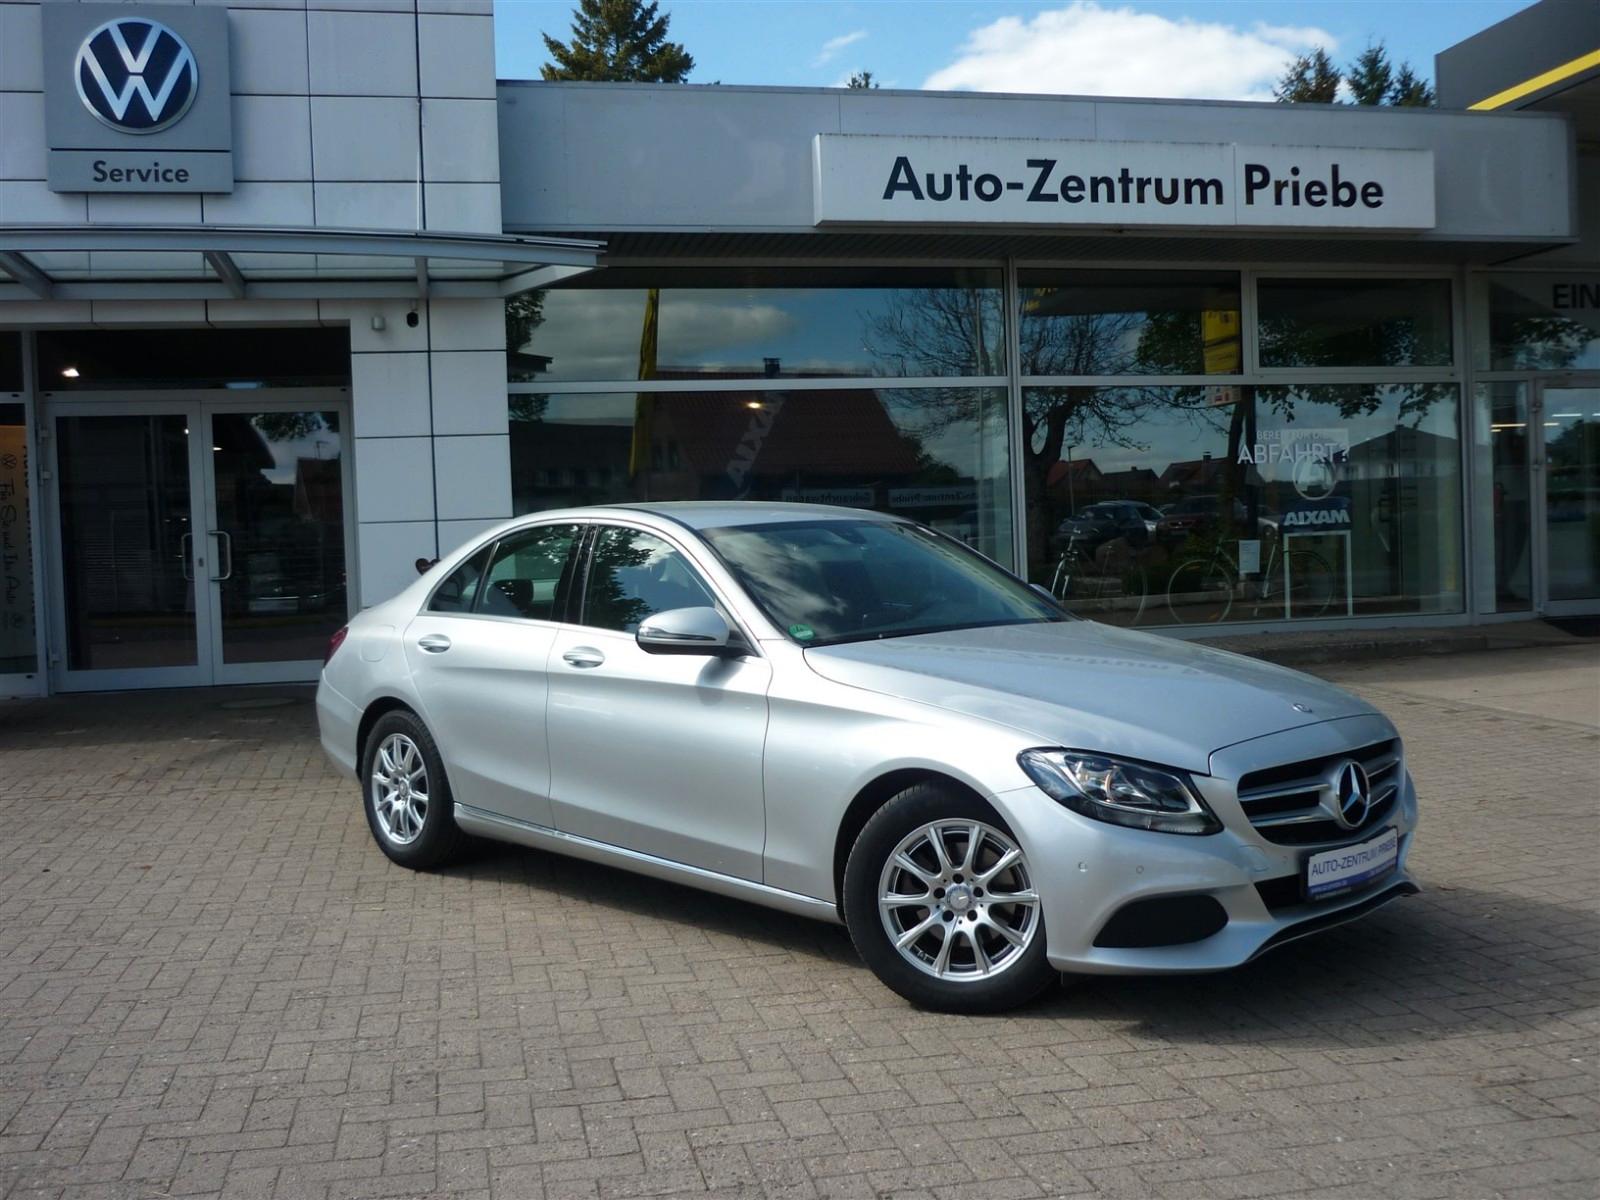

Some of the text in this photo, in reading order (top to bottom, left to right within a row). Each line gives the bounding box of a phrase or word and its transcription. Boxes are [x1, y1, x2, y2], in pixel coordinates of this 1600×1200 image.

[92, 160, 190, 184] Service
[882, 156, 1385, 210] Auto-Zentrum Priebe
[1553, 284, 1600, 308] EIN
[1237, 443, 1351, 465] ABFAHRT?
[1283, 509, 1351, 526] AIXAM
